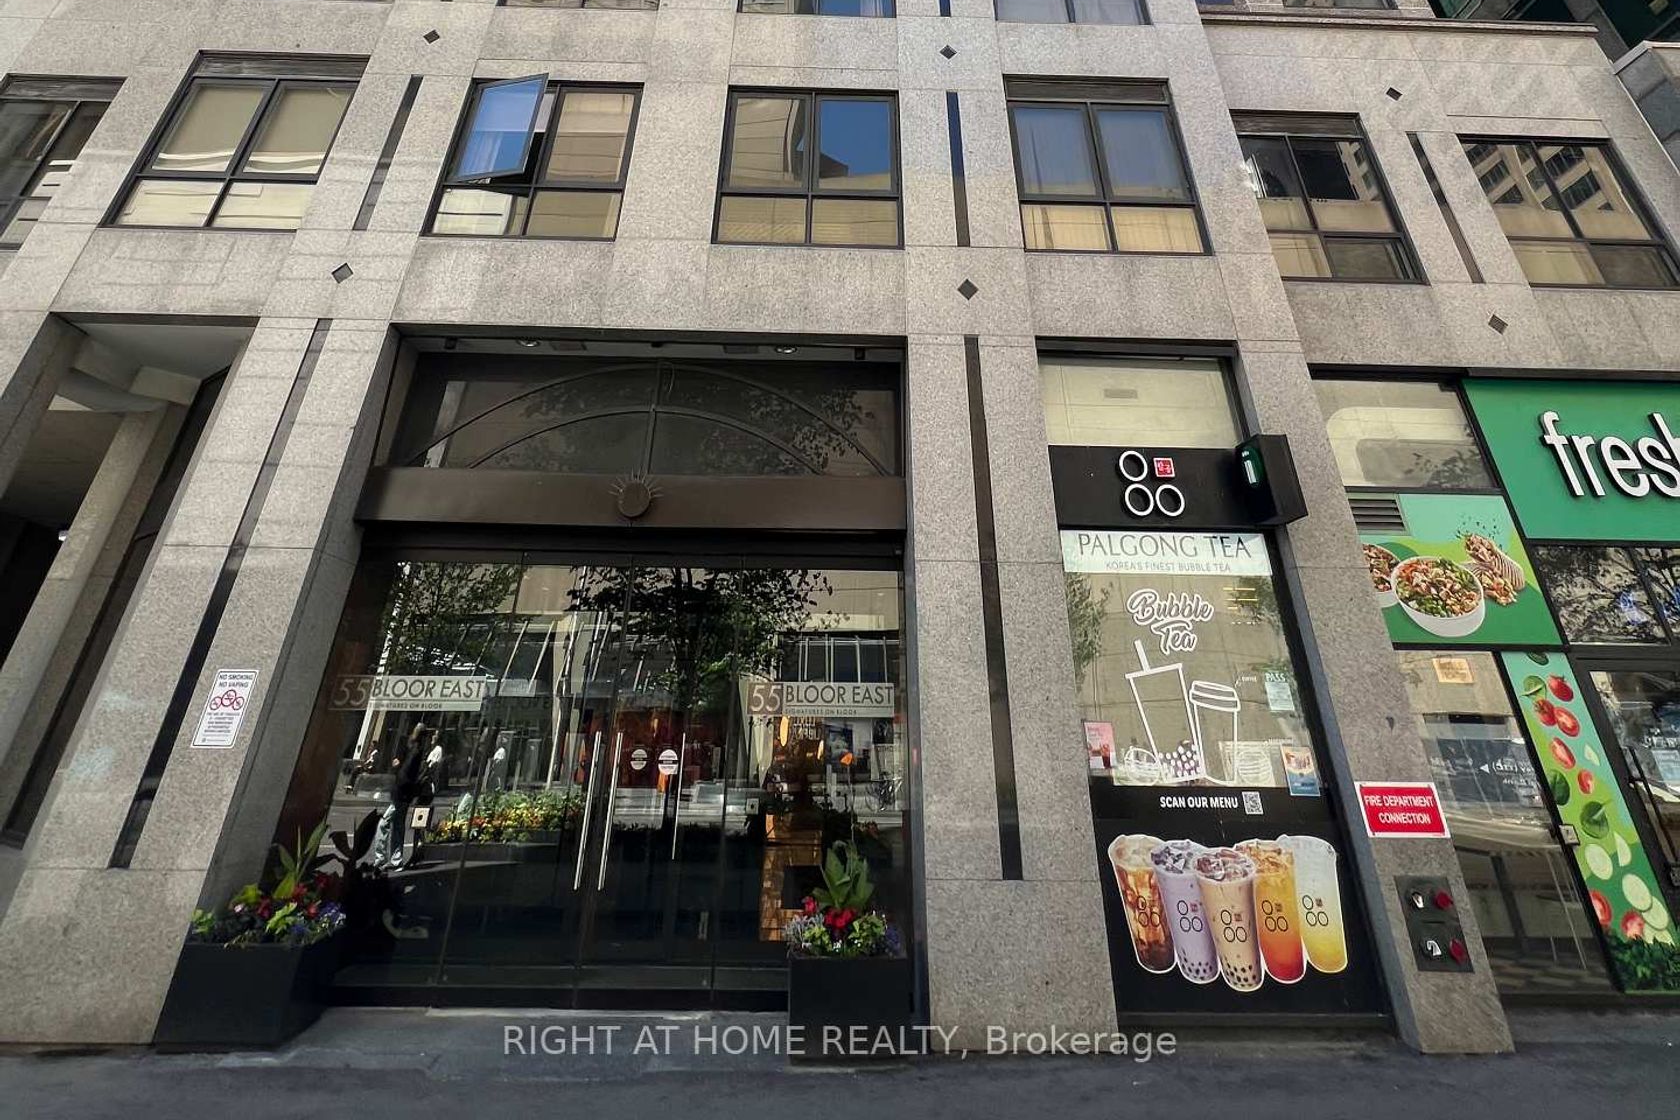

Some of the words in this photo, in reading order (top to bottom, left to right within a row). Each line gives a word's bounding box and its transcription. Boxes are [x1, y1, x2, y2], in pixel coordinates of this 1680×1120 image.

[1078, 533, 1198, 558] PALGONG
[1203, 535, 1251, 558] TEA
[1145, 562, 1176, 571] FINEST
[1178, 563, 1212, 572] BUBBLE
[1214, 563, 1231, 572] TEA
[1126, 588, 1215, 625] Bubble
[1150, 620, 1198, 655] Tea
[1265, 672, 1286, 682] PASS
[333, 679, 370, 706] 55
[372, 679, 436, 698] BLOOR
[440, 680, 485, 698] EAST
[750, 684, 781, 712] 55
[786, 684, 847, 704] BLOOR
[853, 686, 893, 704] EAST
[1160, 796, 1186, 808] SCAN
[1187, 796, 1209, 808] OUR
[1210, 796, 1239, 809] MENU
[1364, 795, 1382, 806] FIRE
[1383, 795, 1434, 807] DEPARTMENT
[1378, 813, 1431, 824] CONNECTION
